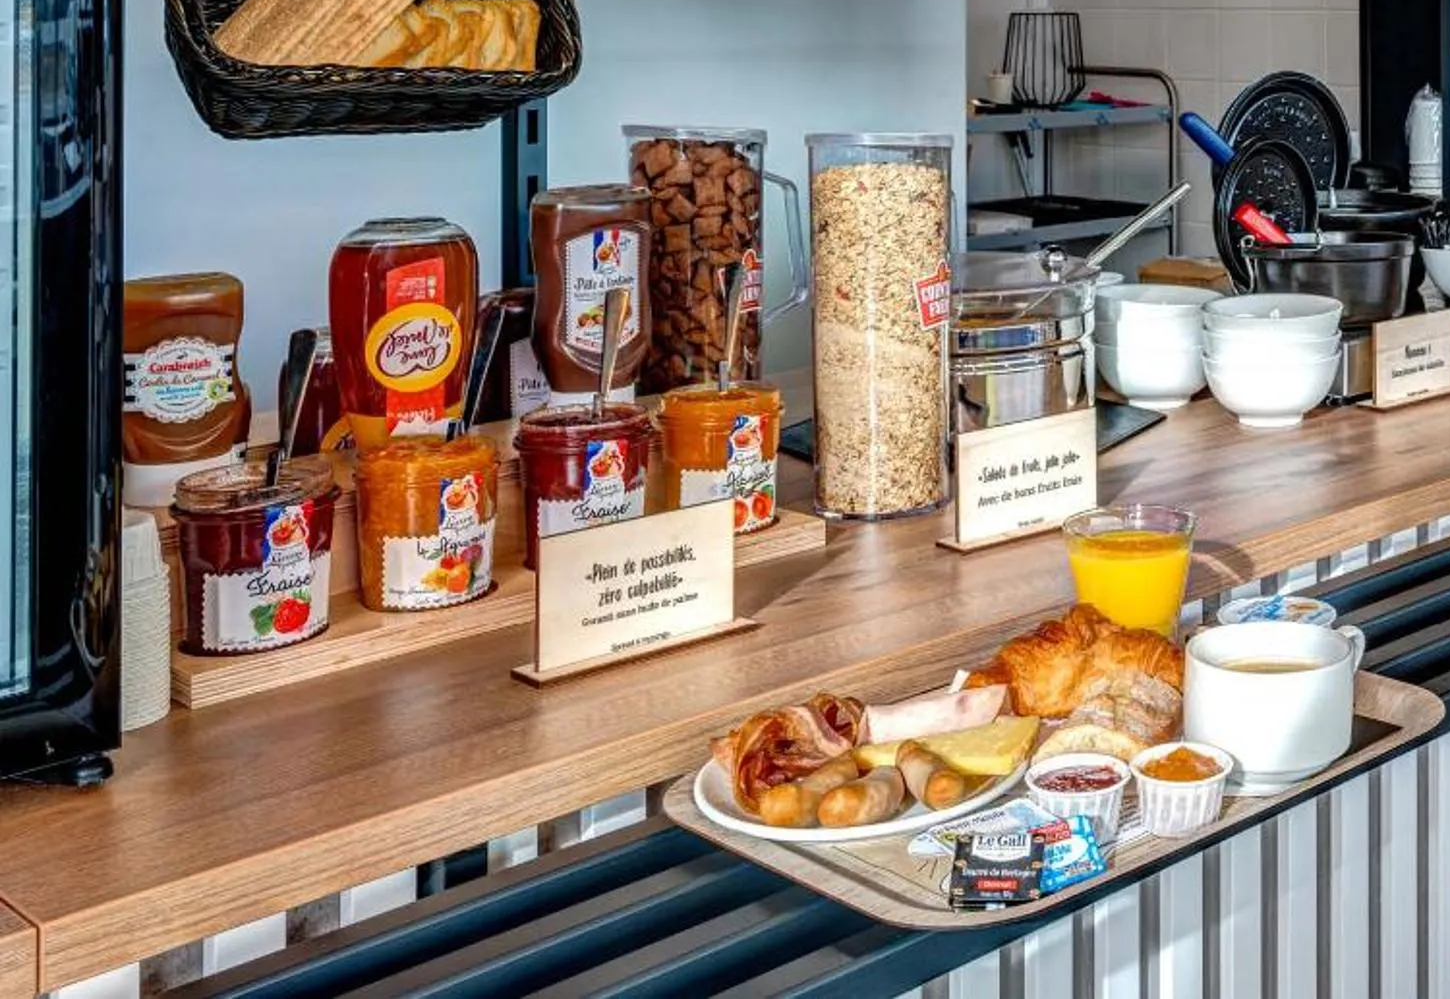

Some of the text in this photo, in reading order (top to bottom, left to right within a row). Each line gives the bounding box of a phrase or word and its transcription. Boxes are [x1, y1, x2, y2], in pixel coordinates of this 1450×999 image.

[624, 558, 635, 576] de
[247, 570, 312, 597] Fraise
[598, 588, 622, 607] zéro
[661, 598, 671, 608] de
[978, 833, 1027, 848] Le Gall
